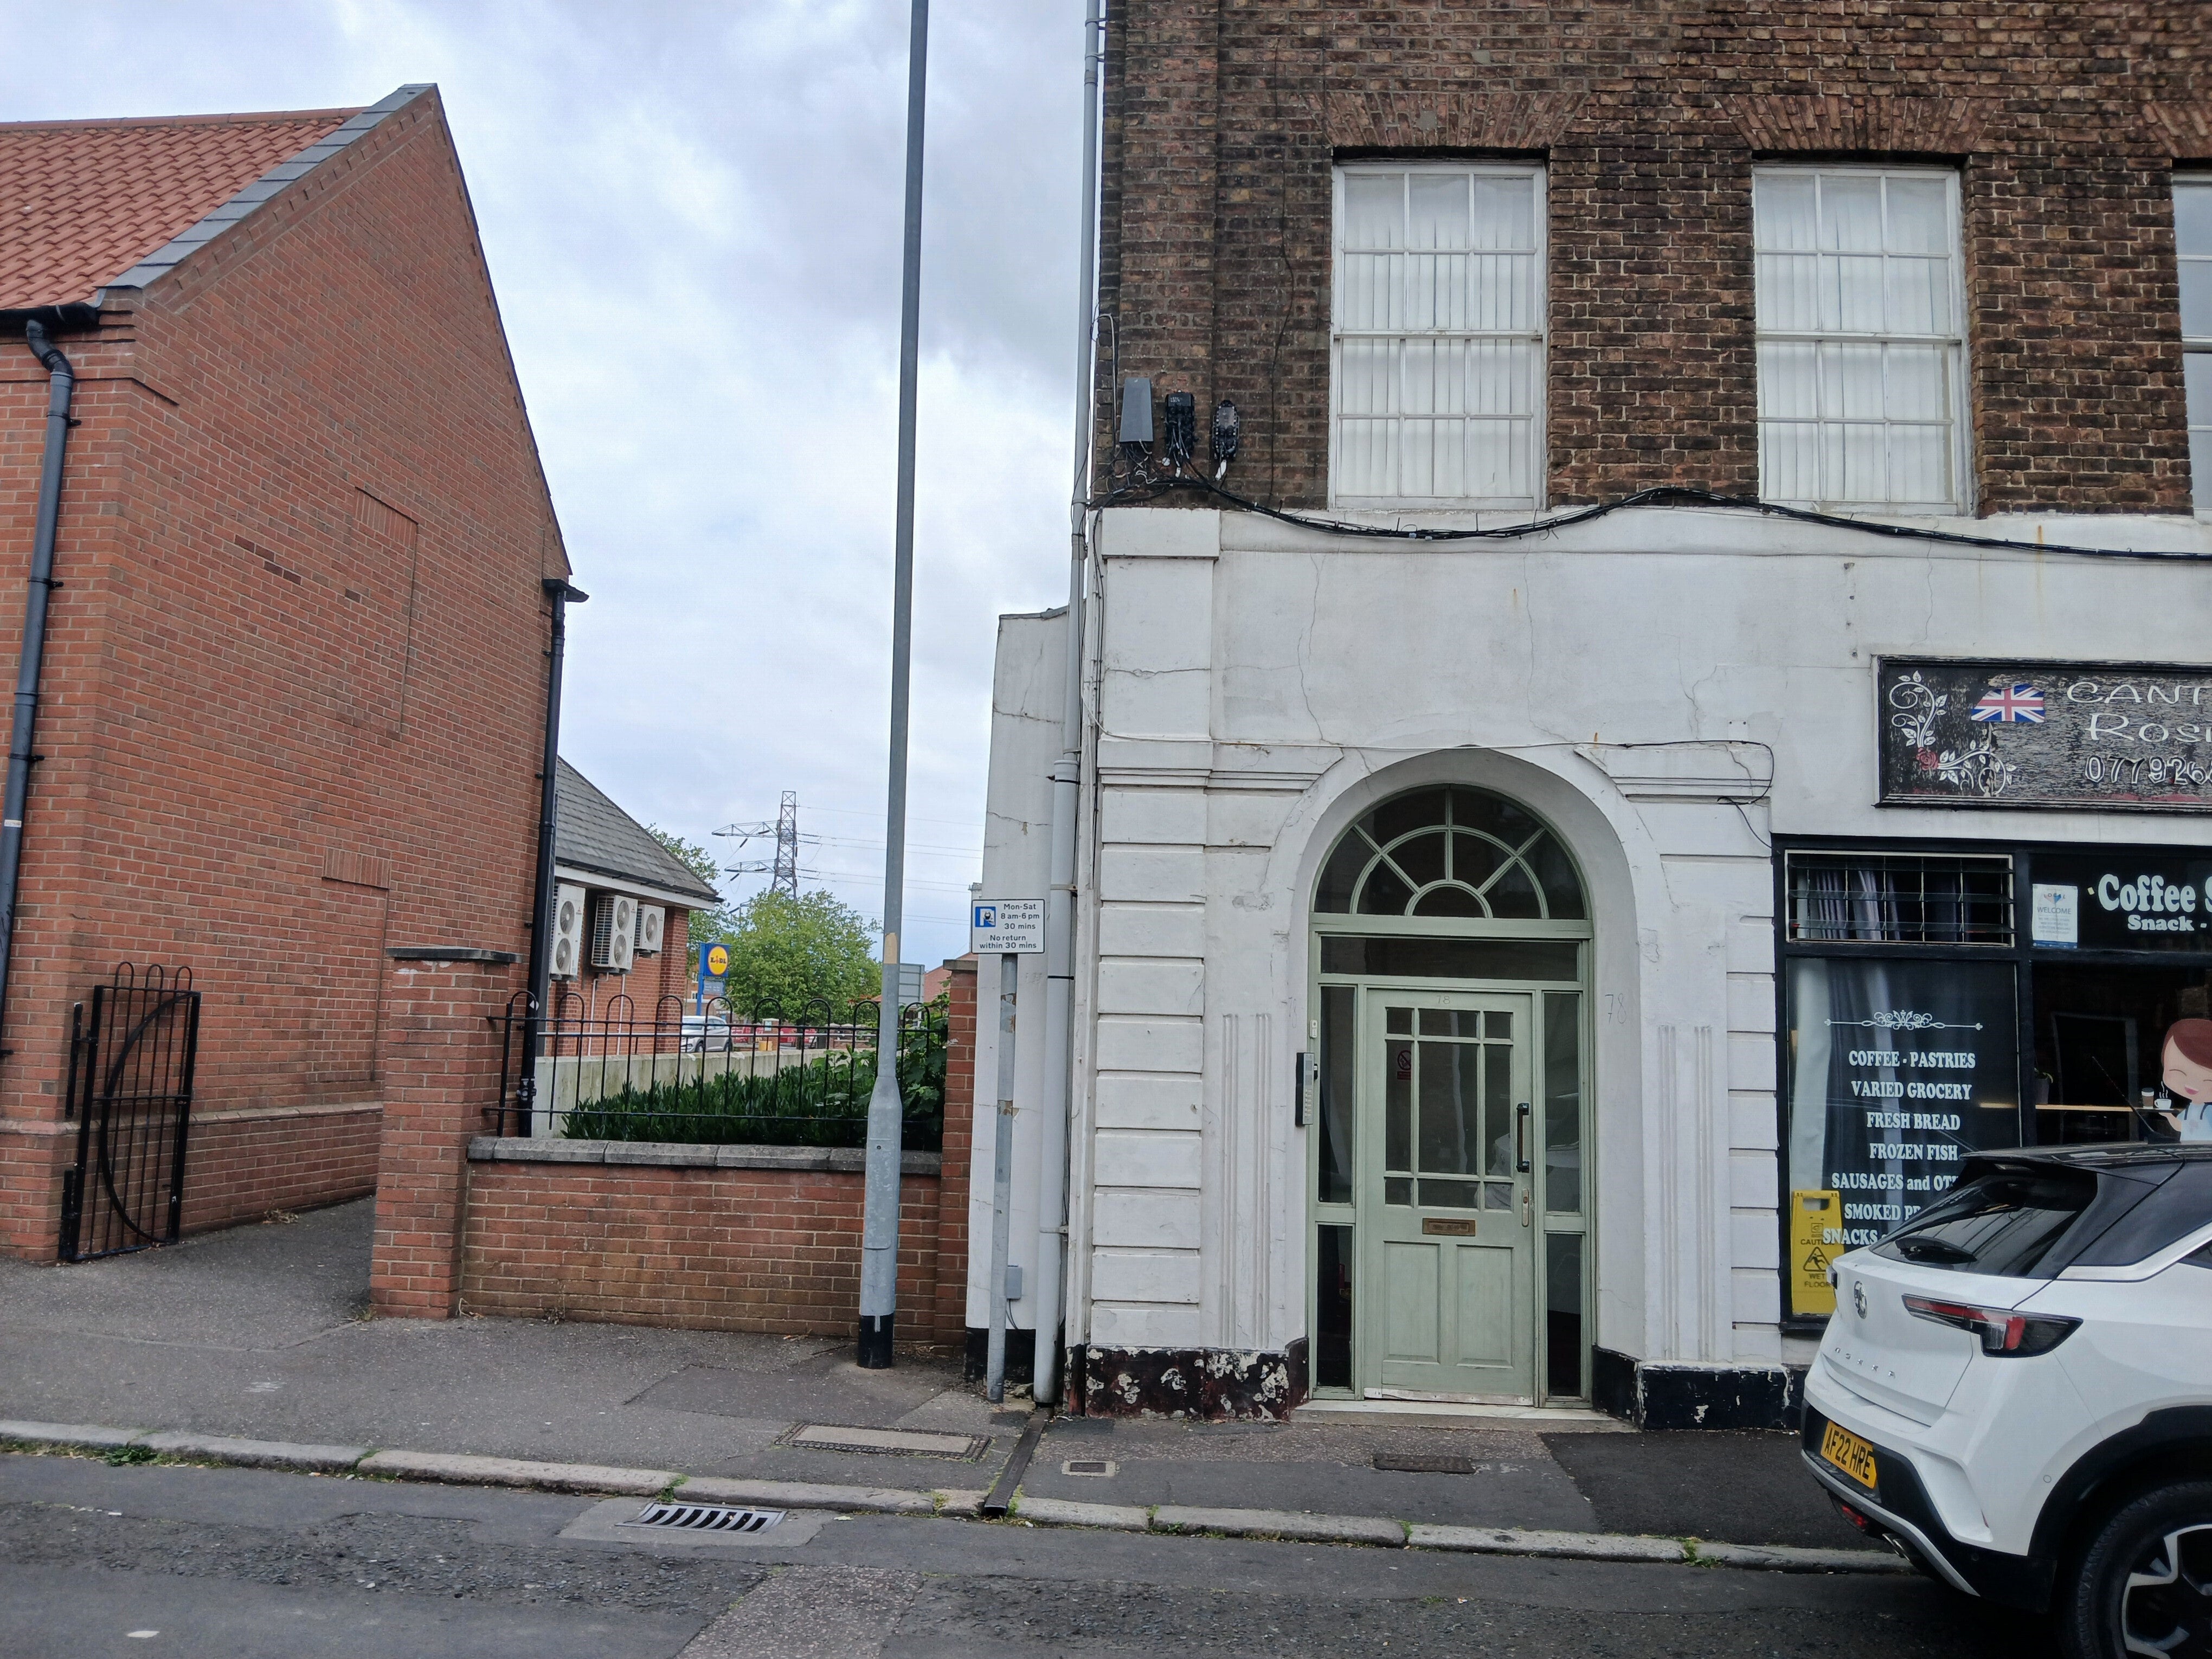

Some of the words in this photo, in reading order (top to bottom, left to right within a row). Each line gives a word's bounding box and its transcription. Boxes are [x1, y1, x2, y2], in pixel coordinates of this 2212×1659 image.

[2085, 754, 2212, 785] 077926
[2098, 873, 2196, 912] Coffee
[2127, 914, 2195, 931] Snack
[1437, 995, 1450, 1004] 78
[1605, 993, 1626, 1025] 78
[1849, 1051, 1900, 1067] COFFEE
[1909, 1052, 1976, 1069] PASTRIES
[1851, 1081, 1904, 1098] VARIED
[1907, 1083, 1972, 1100] GROCERY
[1867, 1112, 1911, 1129] FRESH
[1913, 1114, 1960, 1130] BREAD
[1869, 1143, 1924, 1160] FROZEN
[1927, 1144, 1958, 1161] FISH
[1831, 1172, 1904, 1190] SAUSAGES
[1907, 1175, 1931, 1191] and
[1844, 1203, 1901, 1220] SMOKED
[1823, 1227, 1877, 1245] SNACKS
[1825, 1427, 1851, 1465] AF22
[1849, 1442, 1875, 1481] HRE
